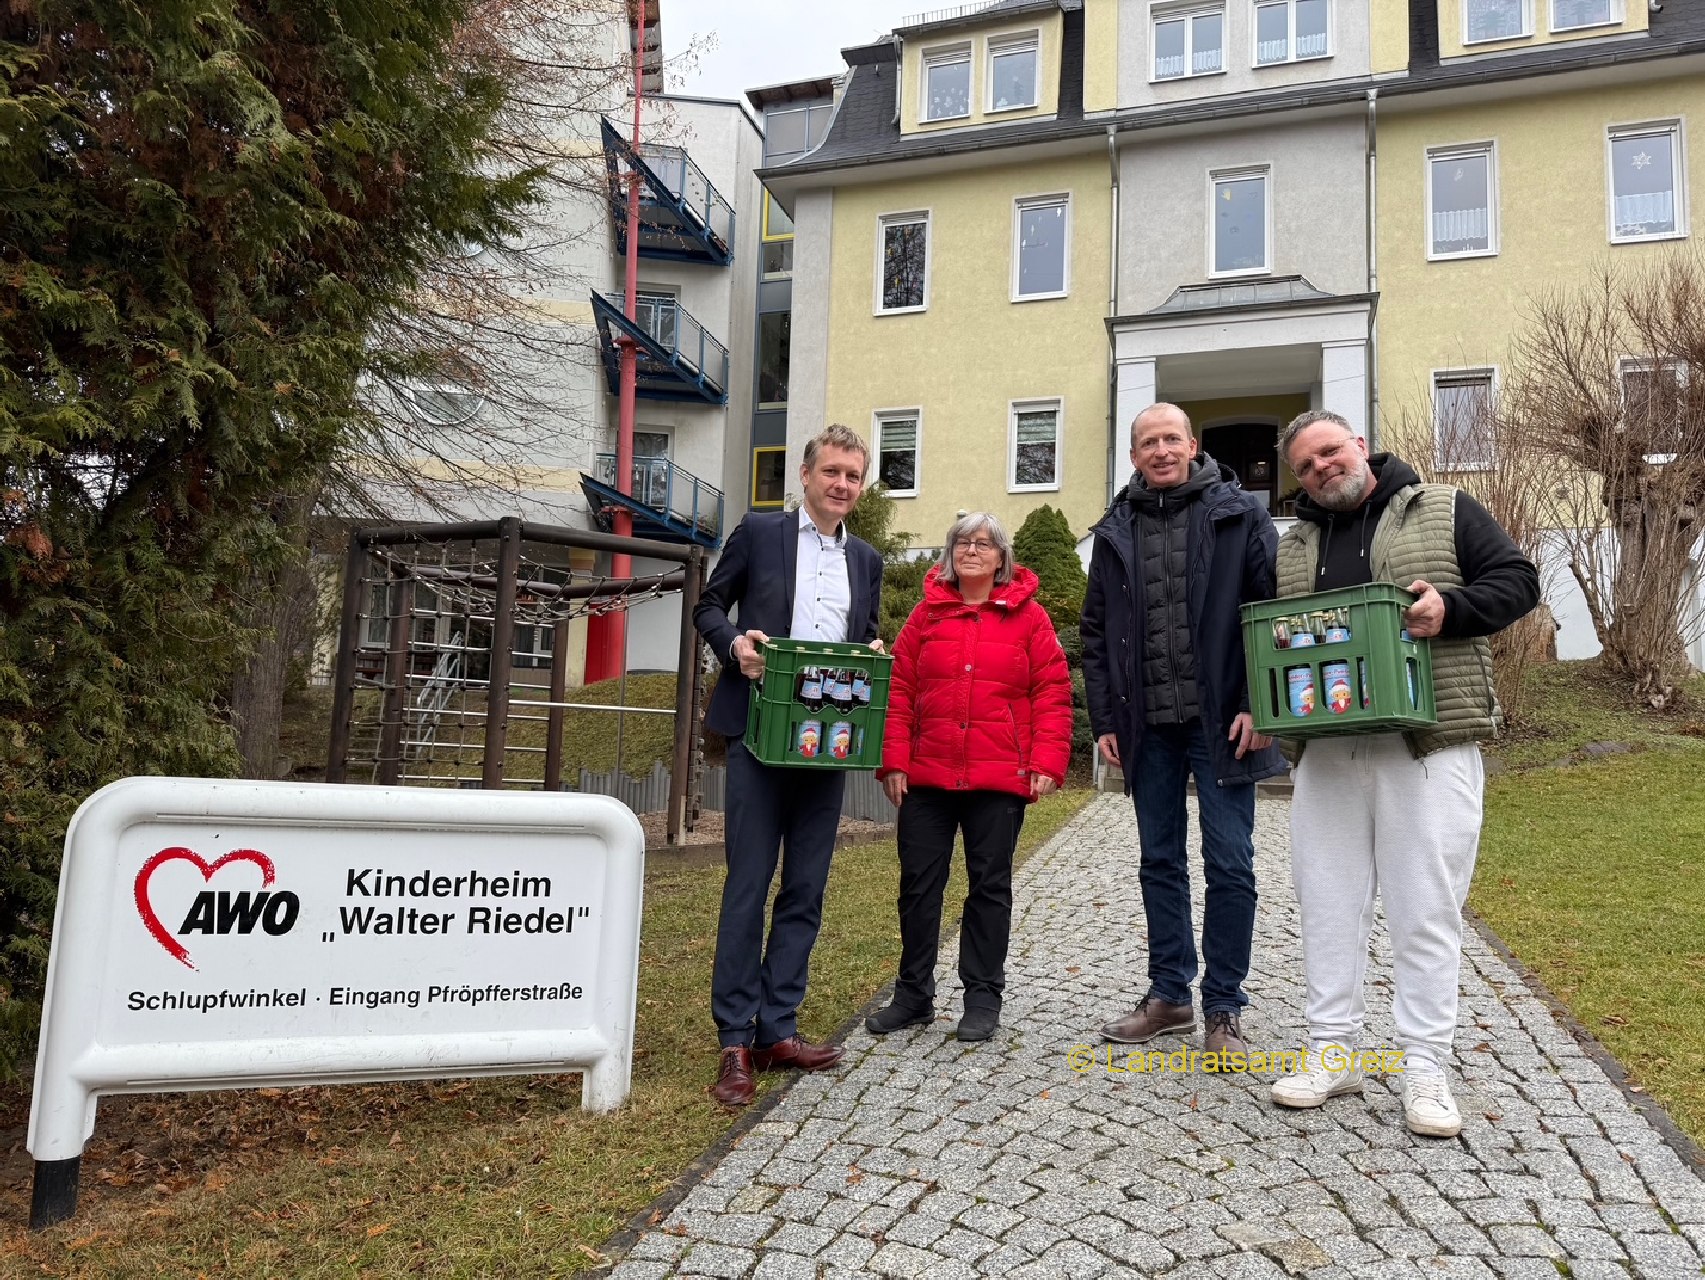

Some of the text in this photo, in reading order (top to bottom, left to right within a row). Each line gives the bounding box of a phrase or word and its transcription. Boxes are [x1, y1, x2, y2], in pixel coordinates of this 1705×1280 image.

[346, 868, 552, 898] Kinderheim
[177, 890, 300, 937] AWO
[127, 987, 306, 1014] Schlupfwinkel
[329, 986, 421, 1009] Eingang
[427, 982, 583, 1007] Pfröpfferstraße
